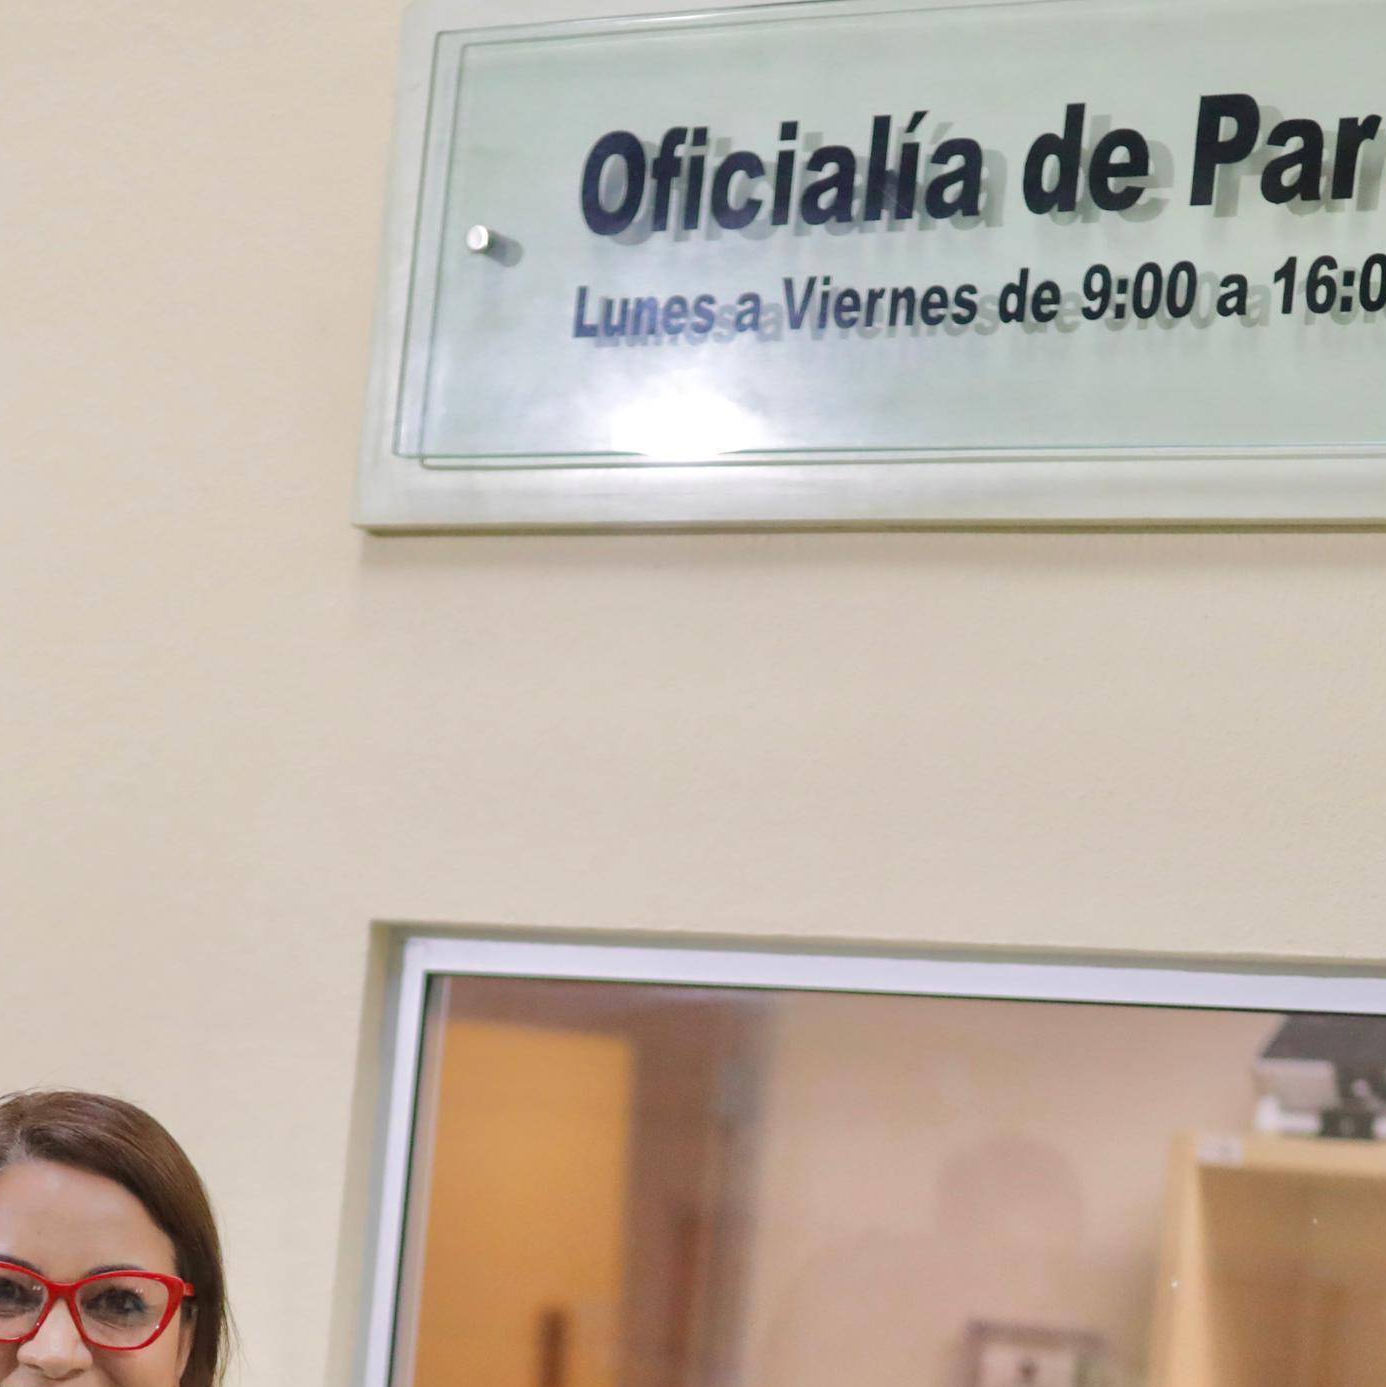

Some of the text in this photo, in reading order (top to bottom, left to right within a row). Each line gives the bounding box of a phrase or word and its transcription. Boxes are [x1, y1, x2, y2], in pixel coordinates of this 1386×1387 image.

[580, 110, 984, 236] Oficialía
[1023, 102, 1150, 216] de
[572, 286, 715, 338] Lunes
[734, 293, 763, 333] a
[782, 275, 979, 329] Viernes
[999, 268, 1061, 323] de
[1080, 261, 1198, 321] 9:00
[1215, 274, 1248, 317] a
